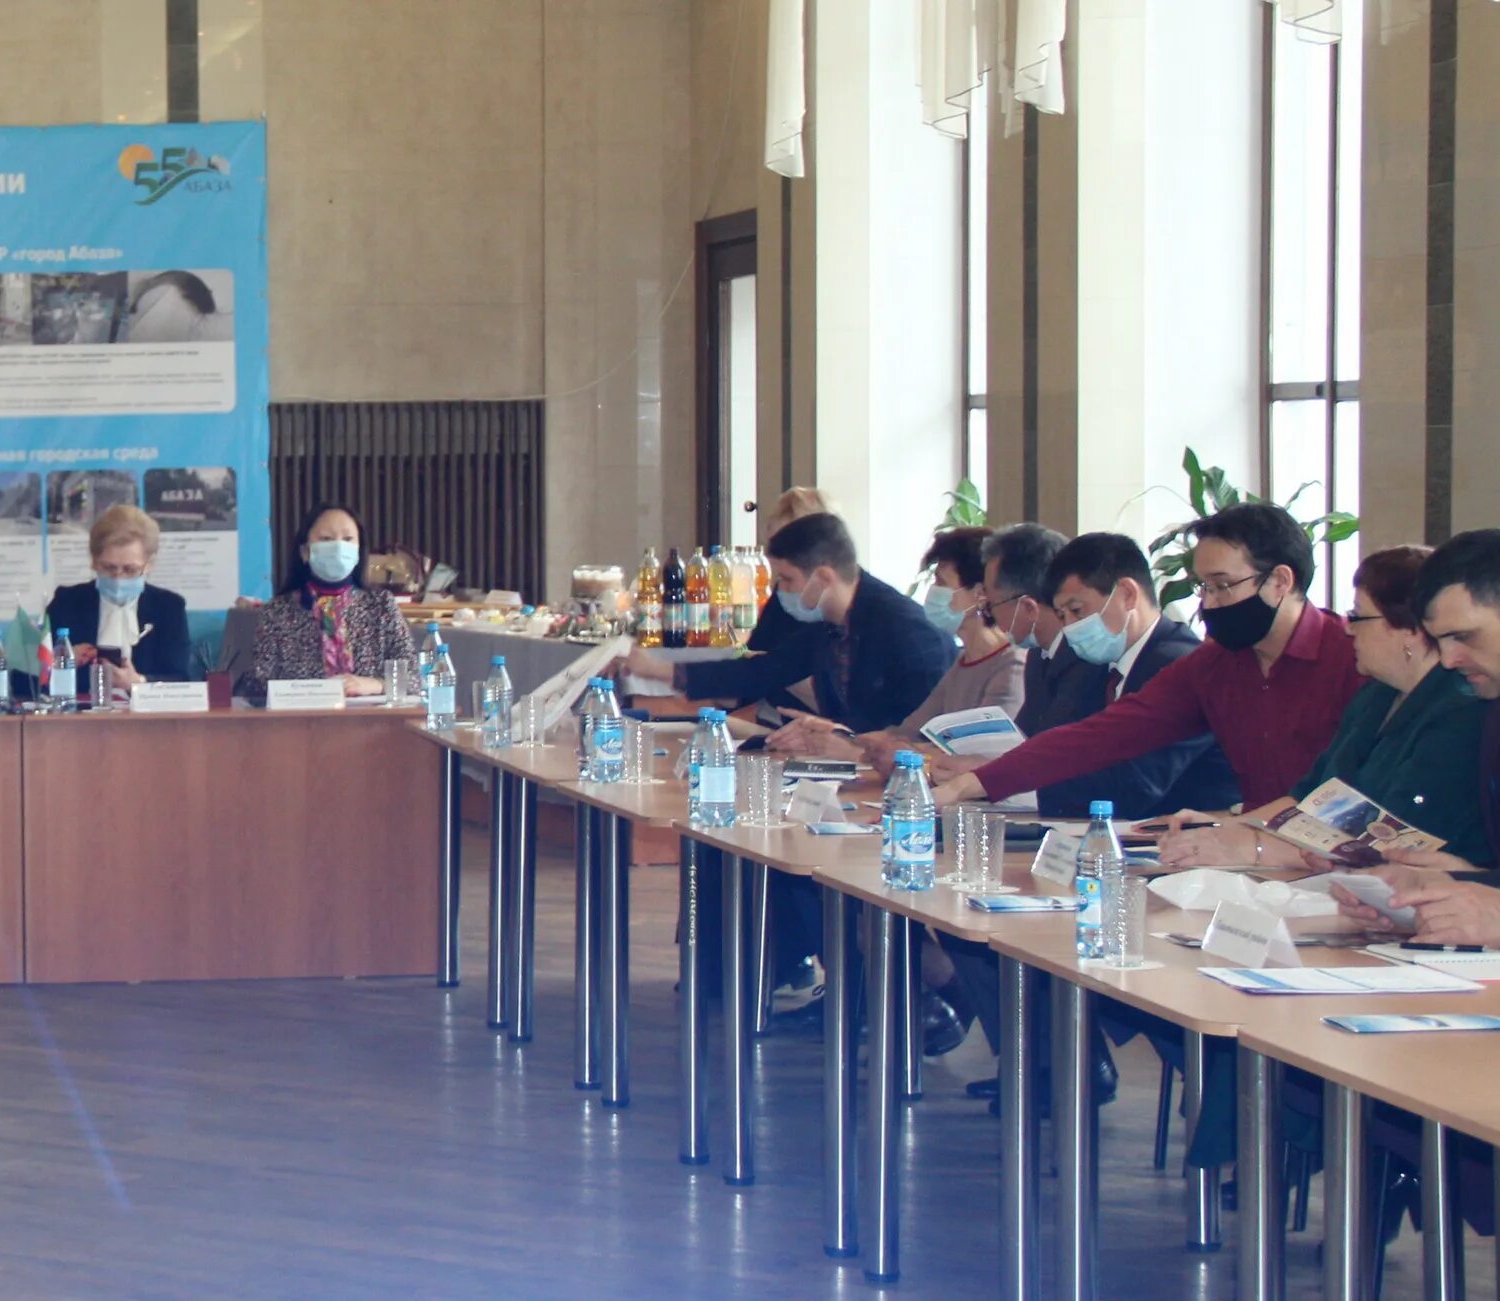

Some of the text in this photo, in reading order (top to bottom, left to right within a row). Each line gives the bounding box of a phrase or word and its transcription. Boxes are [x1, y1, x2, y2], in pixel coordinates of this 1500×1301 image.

[183, 180, 232, 192] АБАЗА
[11, 248, 66, 264] «город
[69, 245, 124, 260] Абаза»
[29, 449, 110, 464] городская
[113, 447, 159, 461] среда
